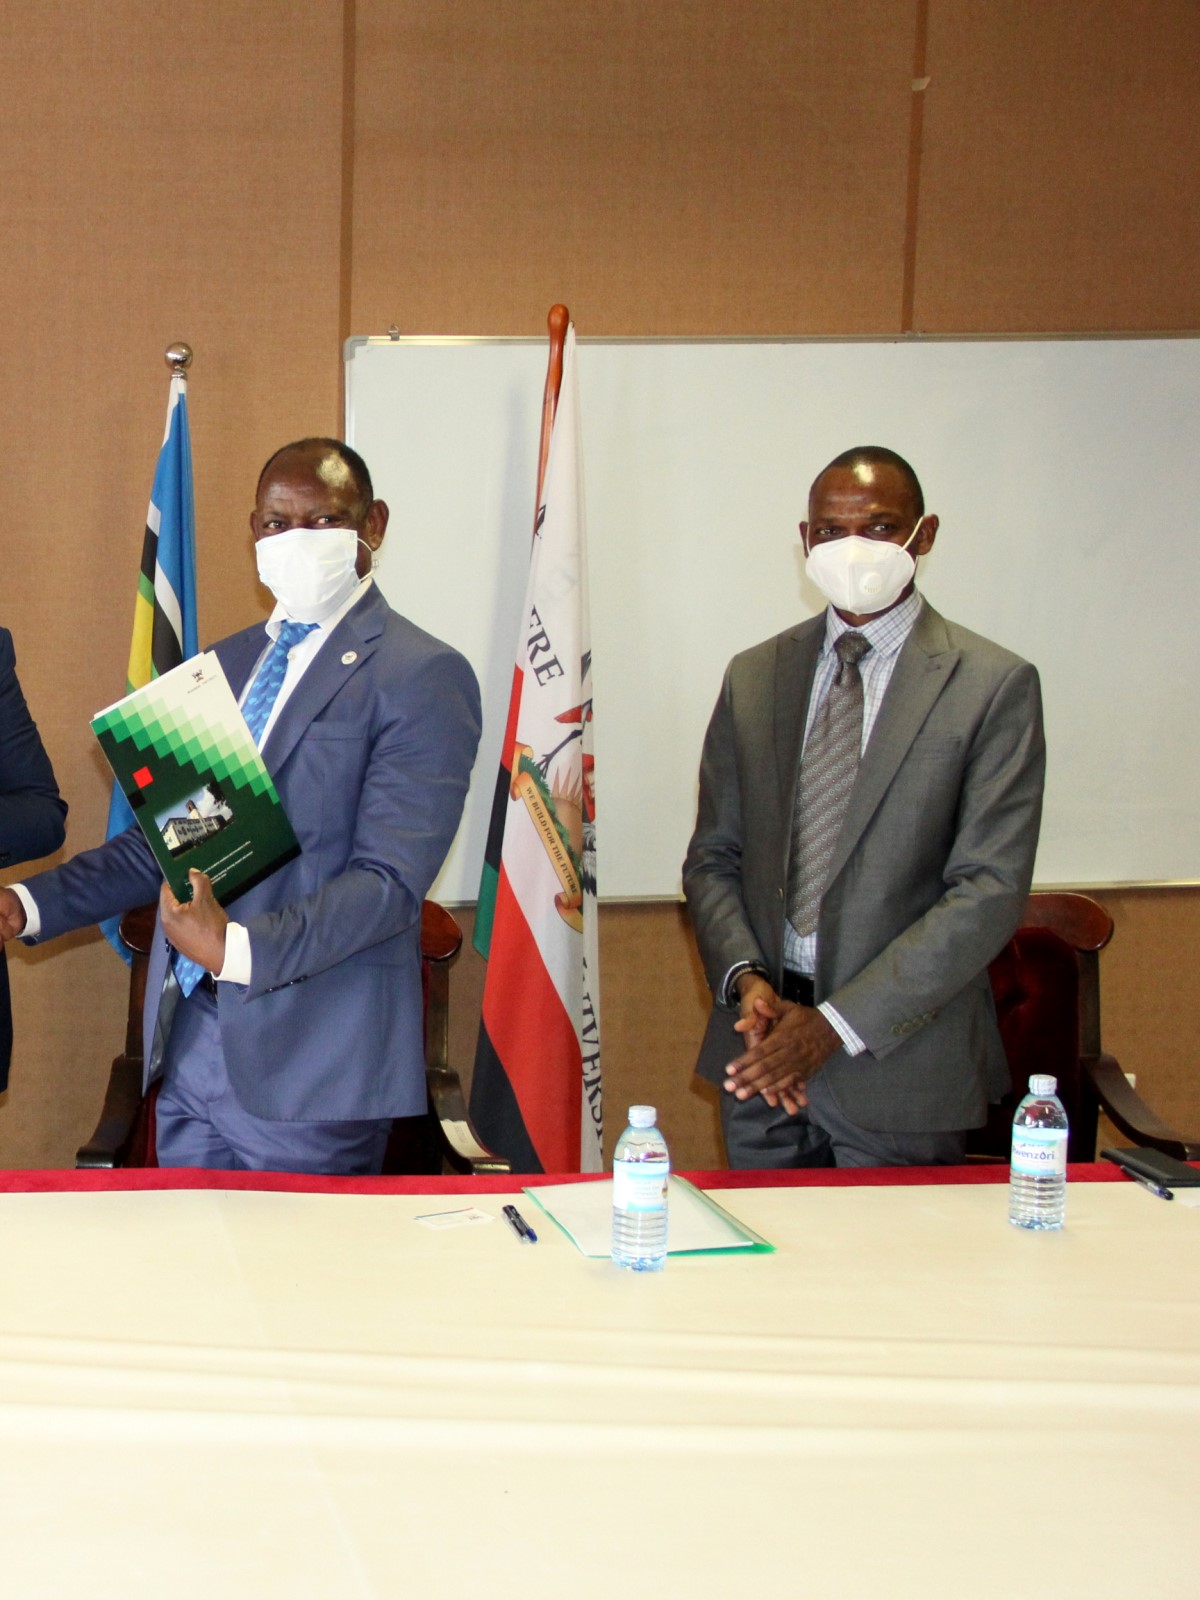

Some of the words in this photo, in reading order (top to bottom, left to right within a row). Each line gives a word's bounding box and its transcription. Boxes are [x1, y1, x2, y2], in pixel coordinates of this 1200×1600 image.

[526, 786, 536, 801] WE
[532, 801, 548, 829] BUILD
[544, 827, 556, 845] FOR
[552, 844, 564, 862] THE
[560, 863, 578, 893] FUTURE
